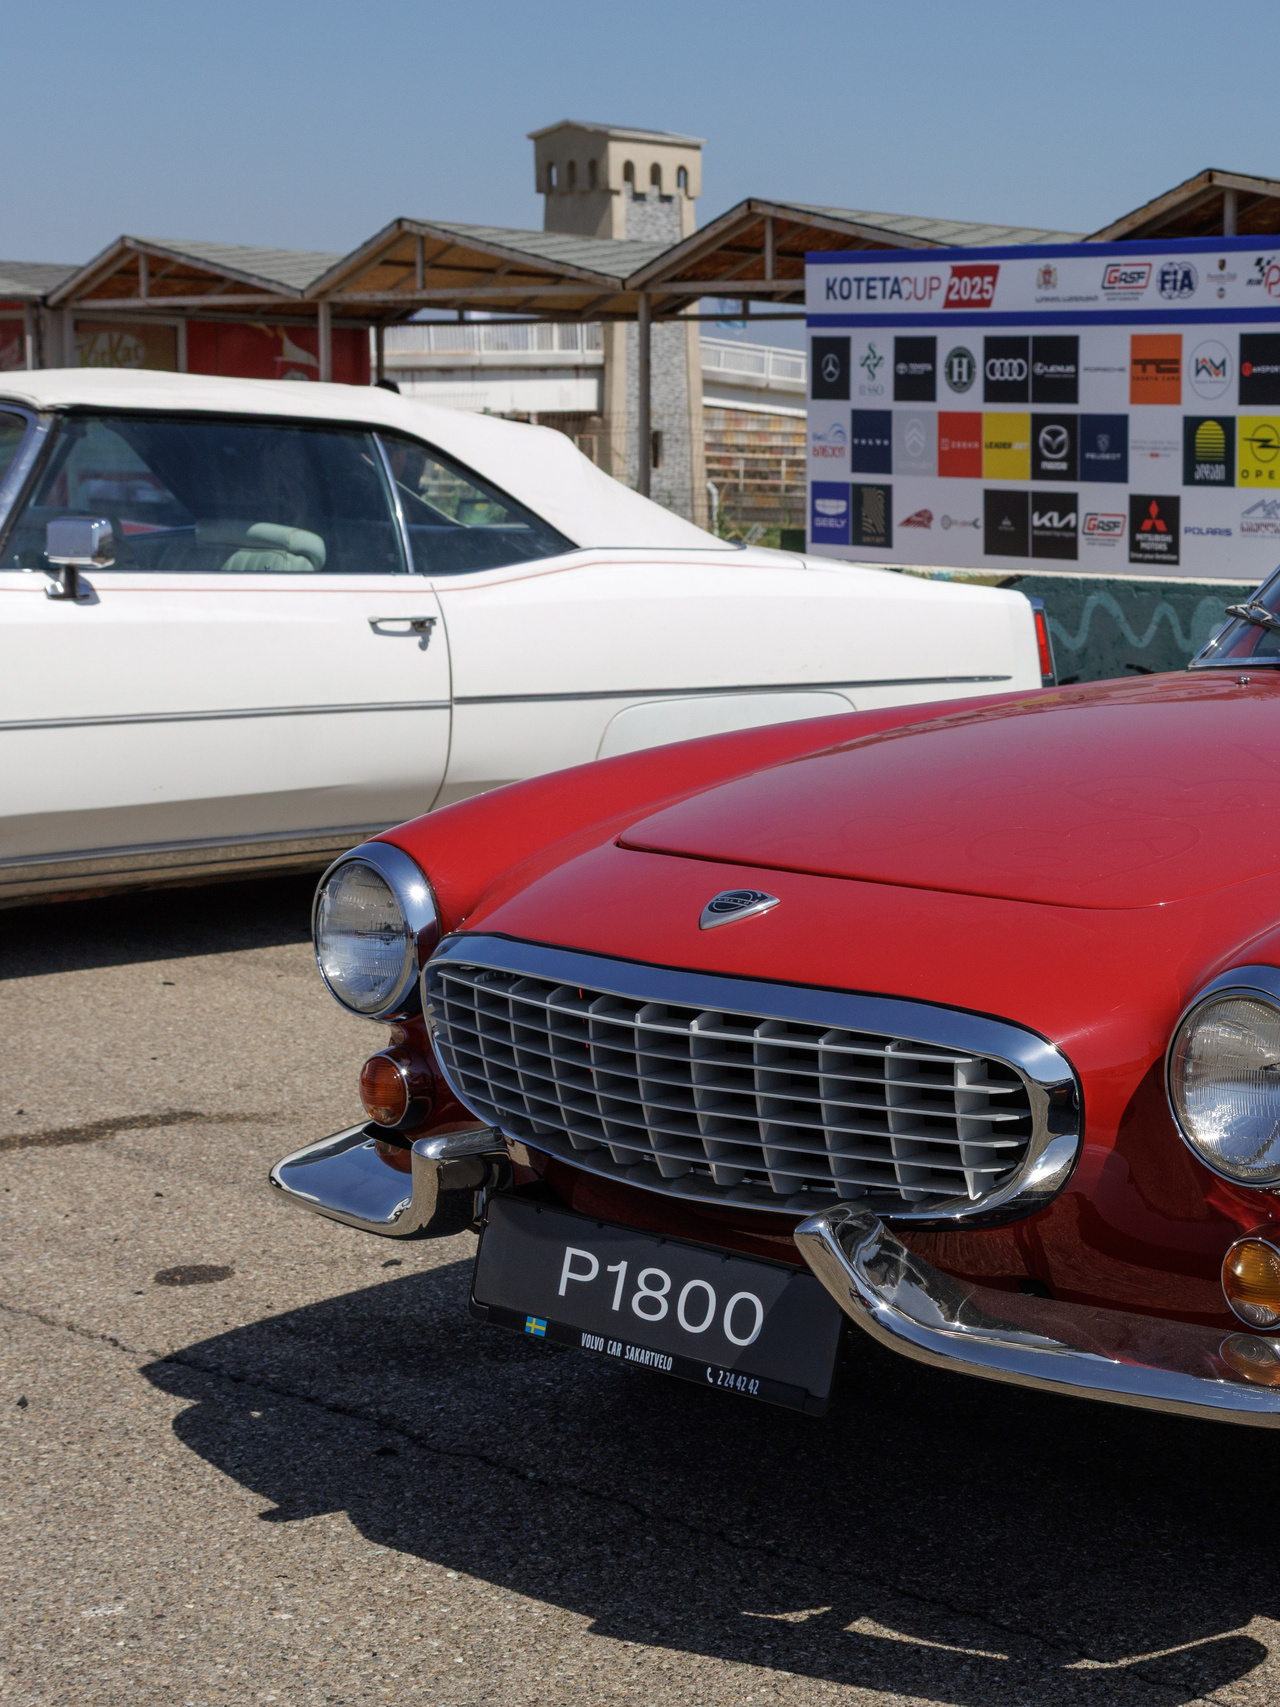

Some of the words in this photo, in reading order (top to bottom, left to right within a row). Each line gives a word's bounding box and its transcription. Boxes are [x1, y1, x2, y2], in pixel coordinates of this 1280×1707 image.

[949, 276, 993, 300] 2025
[908, 362, 933, 371] TOYOTA
[1044, 364, 1076, 373] LEXUS
[853, 438, 890, 446] VOLVO
[1085, 452, 1121, 460] PEUGEOT
[814, 517, 847, 529] GEELY
[1183, 526, 1232, 537] POLARIS
[1140, 542, 1168, 551] MOTORS
[558, 1246, 764, 1346] P1800
[581, 1333, 604, 1352] VOLVO
[606, 1340, 622, 1358] CAR
[624, 1345, 673, 1371] SAKARTVELO
[717, 1370, 724, 1385] 2
[724, 1372, 735, 1388] 24
[736, 1375, 747, 1391] 42
[748, 1379, 760, 1395] 42
